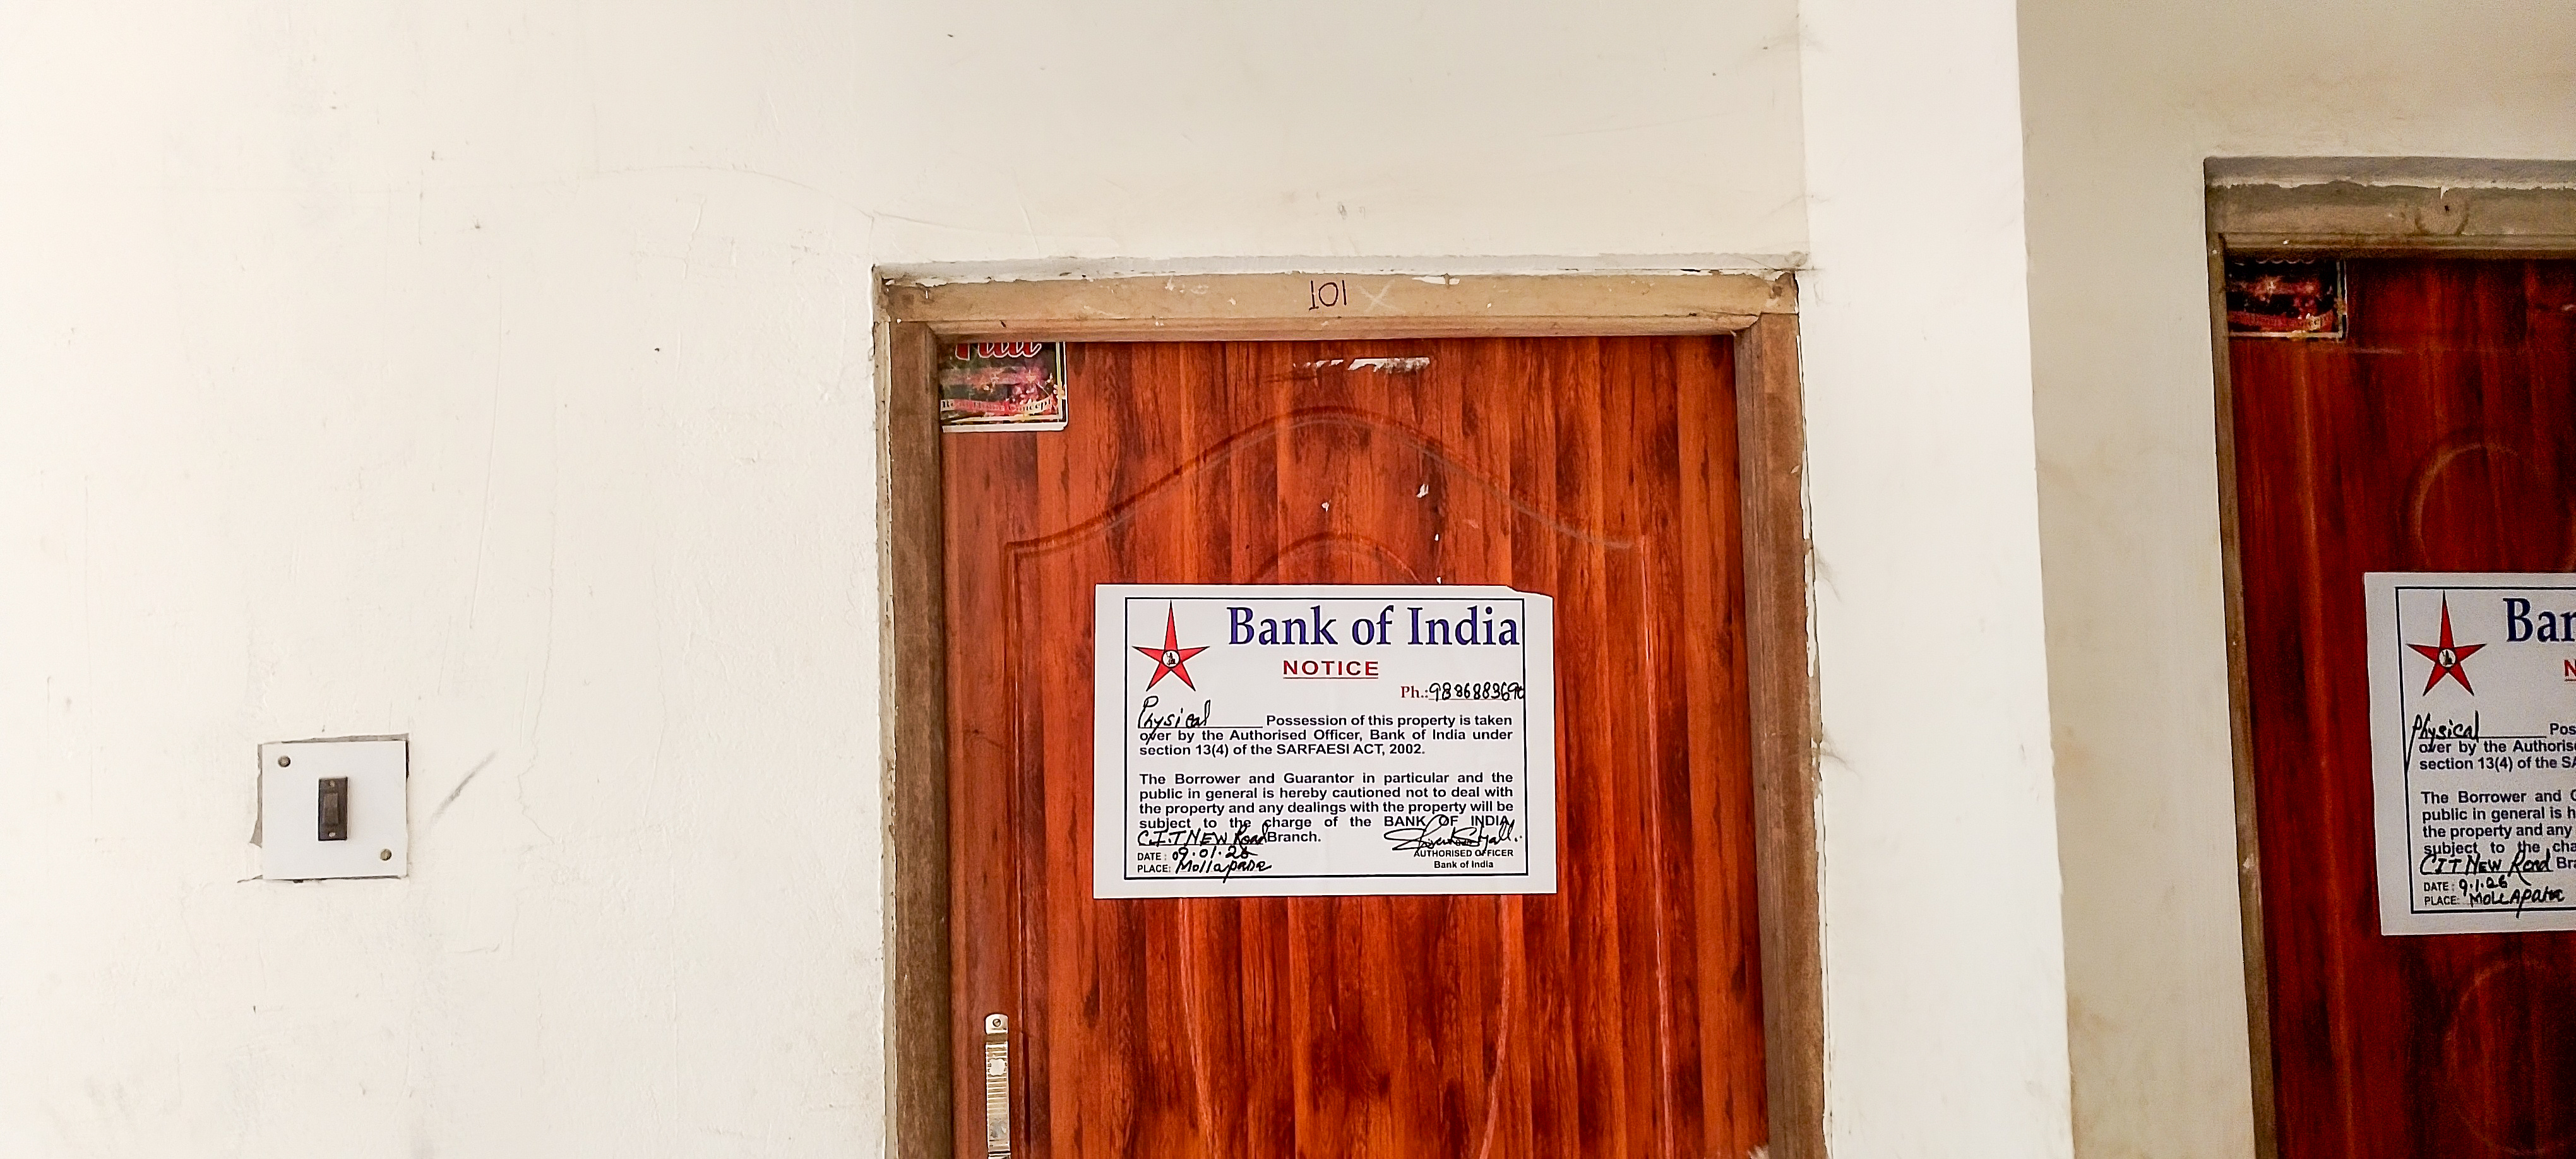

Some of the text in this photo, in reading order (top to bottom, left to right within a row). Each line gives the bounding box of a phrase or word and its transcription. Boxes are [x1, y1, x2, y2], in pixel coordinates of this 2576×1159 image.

[1309, 280, 1347, 311] 101
[1227, 605, 1520, 645] Bank of India
[1283, 660, 1378, 676] NOTICE
[1267, 715, 1346, 726] Possession
[1351, 715, 1366, 725] of
[1368, 715, 1393, 725] this
[1398, 715, 1457, 729] property
[1460, 715, 1470, 725] is
[1475, 715, 1512, 725] taken
[1140, 728, 1513, 743] over by the Authorised Officer, Bank of India under
[2406, 710, 2479, 771] Physical
[1140, 744, 1425, 758] section 13(4) of the SARFAESI ACT, 2002.
[2419, 740, 2576, 756] over by the Authoris
[2419, 758, 2474, 770] section
[2478, 756, 2513, 772] 13(4)
[2517, 756, 2532, 768] of
[2535, 756, 2558, 768] the
[1140, 772, 1513, 786] The Borrower and Guarantor in particular and the
[1140, 787, 1513, 802] public in general is hereby cautioned not to deal with
[2421, 792, 2449, 804] The
[2458, 790, 2527, 804] Borrower
[2534, 790, 2561, 802] and
[1140, 801, 1513, 817] the property and any dealings with the property will be
[2422, 807, 2468, 824] public
[2472, 807, 2486, 820] in
[2491, 806, 2545, 823] general
[2550, 806, 2562, 819] is
[1140, 817, 1191, 831] subject
[1203, 818, 1217, 828] to
[1230, 817, 1251, 828] the
[1265, 817, 1311, 830] charge
[1325, 816, 1339, 828] of
[1350, 816, 1371, 827] the
[1385, 816, 1426, 826] BANK
[1439, 816, 1458, 826] OF
[1267, 831, 1321, 842] Branch.
[2423, 823, 2572, 840] the property and any
[1414, 849, 1514, 858] AUTHORISED OFFICER
[2424, 841, 2478, 857] subject
[2490, 841, 2505, 854] to
[2517, 840, 2541, 853] the
[1138, 864, 1171, 873] PLACE:
[1434, 860, 1494, 869] Bank of India
[2507, 848, 2553, 886] Road
[2424, 895, 2460, 905] PLACE:
